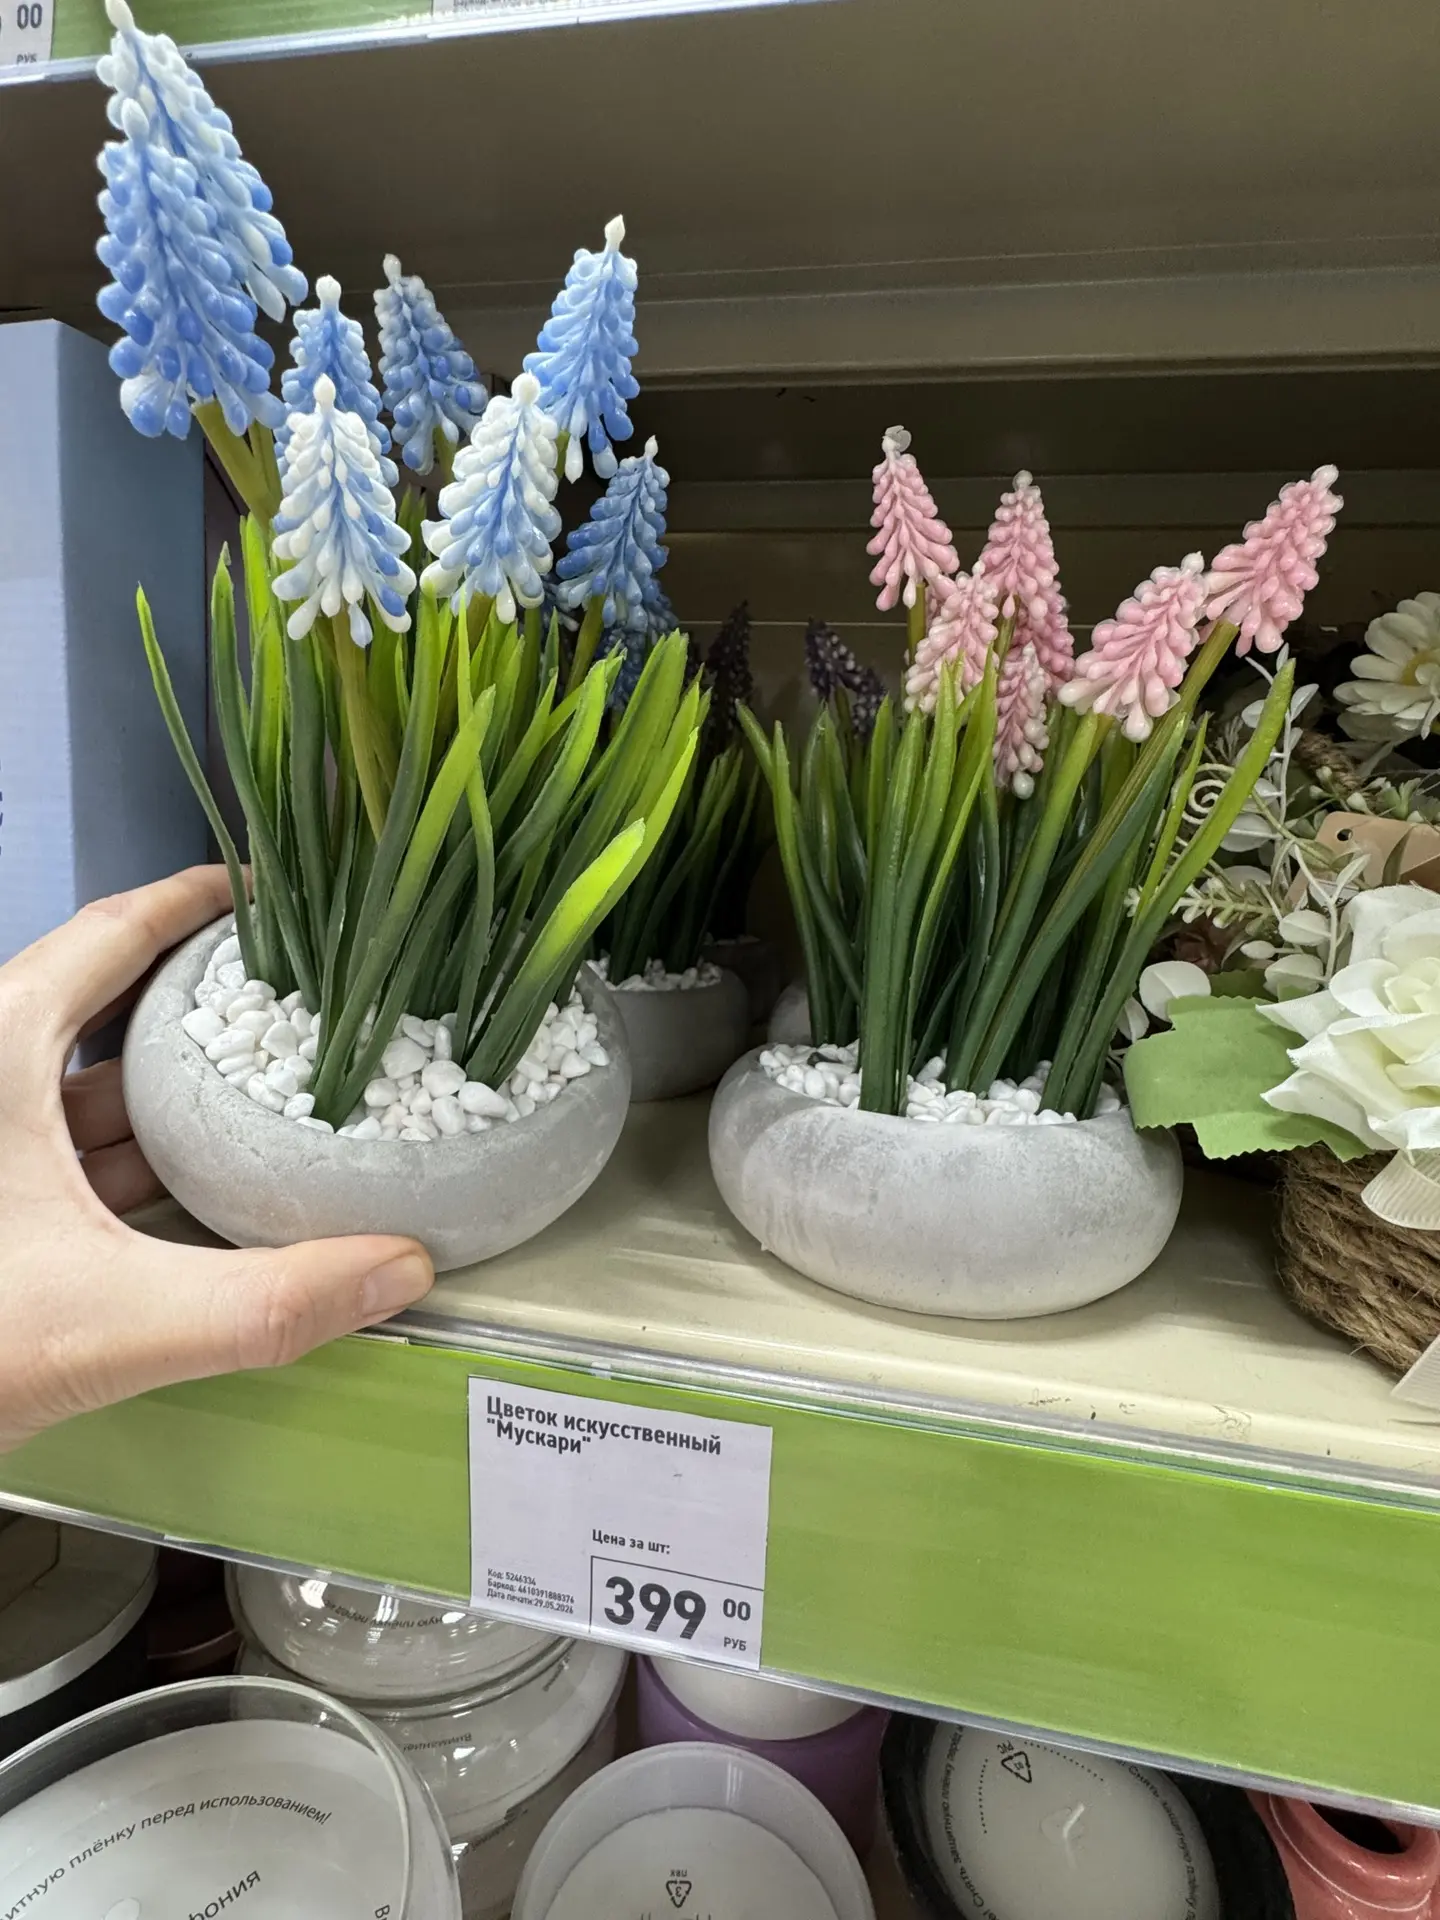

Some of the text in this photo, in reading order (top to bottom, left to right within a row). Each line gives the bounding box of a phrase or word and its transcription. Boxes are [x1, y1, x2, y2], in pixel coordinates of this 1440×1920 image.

[16, 3, 43, 30] 00
[486, 1417, 592, 1455] "Мускари"
[487, 1395, 722, 1455] Цветок искусственный
[592, 1528, 671, 1555] Цена за шт:
[487, 1567, 504, 1580] Код:
[487, 1578, 517, 1592] Баркод:
[486, 1587, 506, 1600] Дата
[604, 1576, 751, 1640] 399 00
[723, 1636, 747, 1651] РУБ
[0, 1794, 334, 1920] итную плёнку перед использованием!
